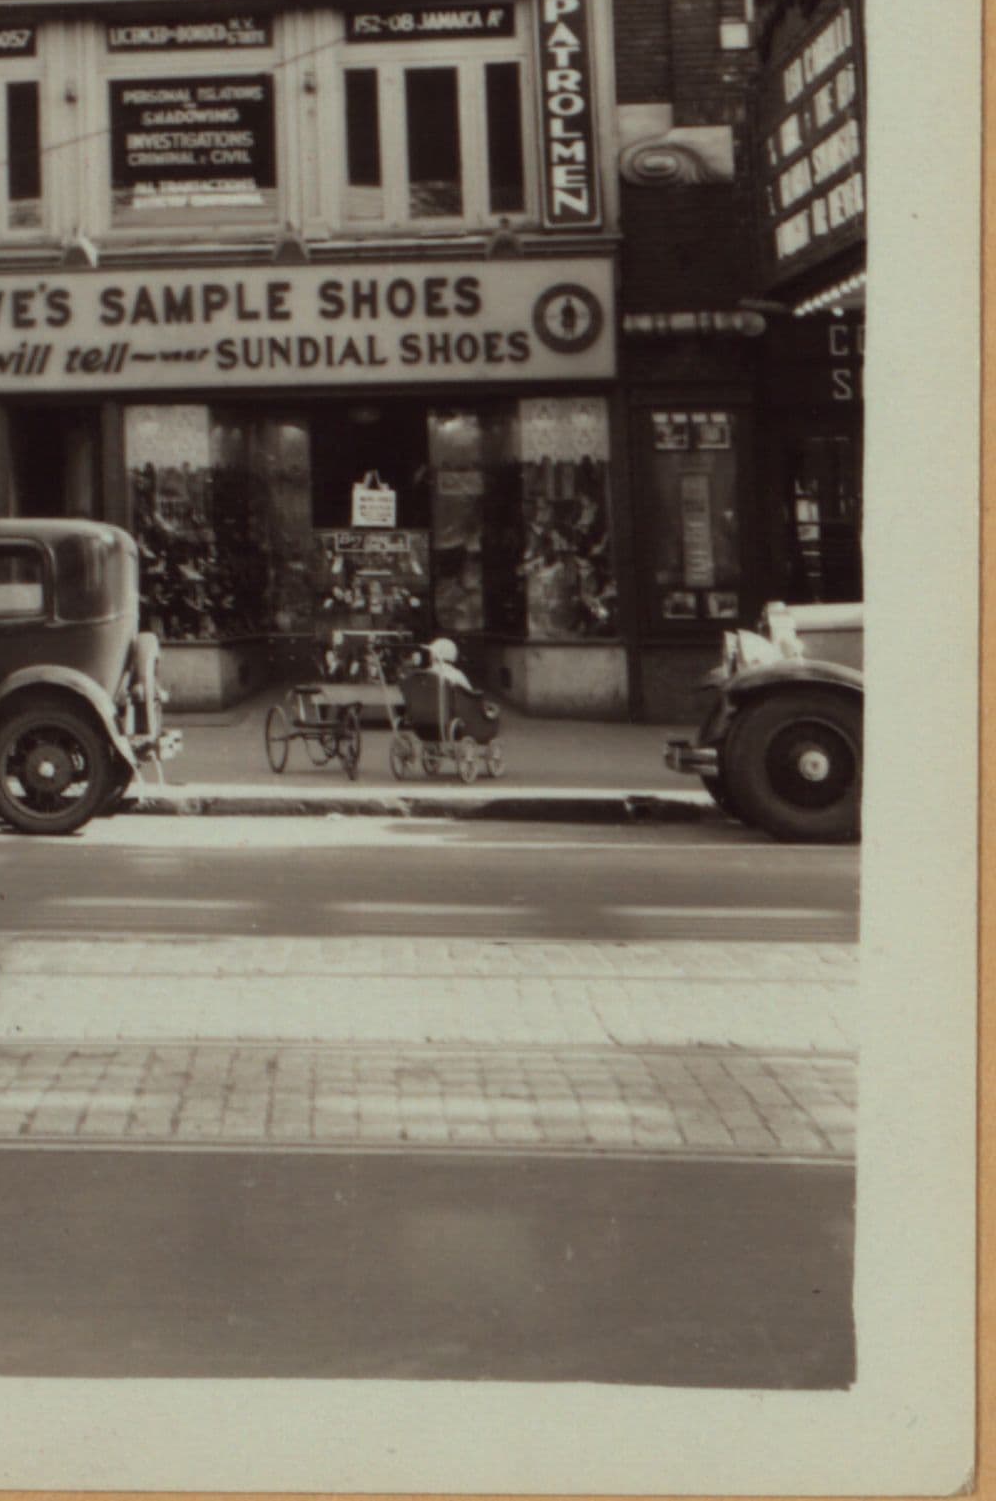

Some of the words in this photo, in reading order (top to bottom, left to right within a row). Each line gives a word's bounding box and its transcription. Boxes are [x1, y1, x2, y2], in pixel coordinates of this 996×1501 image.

[141, 108, 240, 126] SHADOWING
[126, 131, 253, 150] INVESTIGATIONS
[210, 150, 252, 164] CIVIL
[99, 281, 292, 326] SAMPLE
[317, 275, 483, 320] SHOES
[215, 334, 388, 371] SUNDIAL
[399, 331, 531, 365] SHOES
